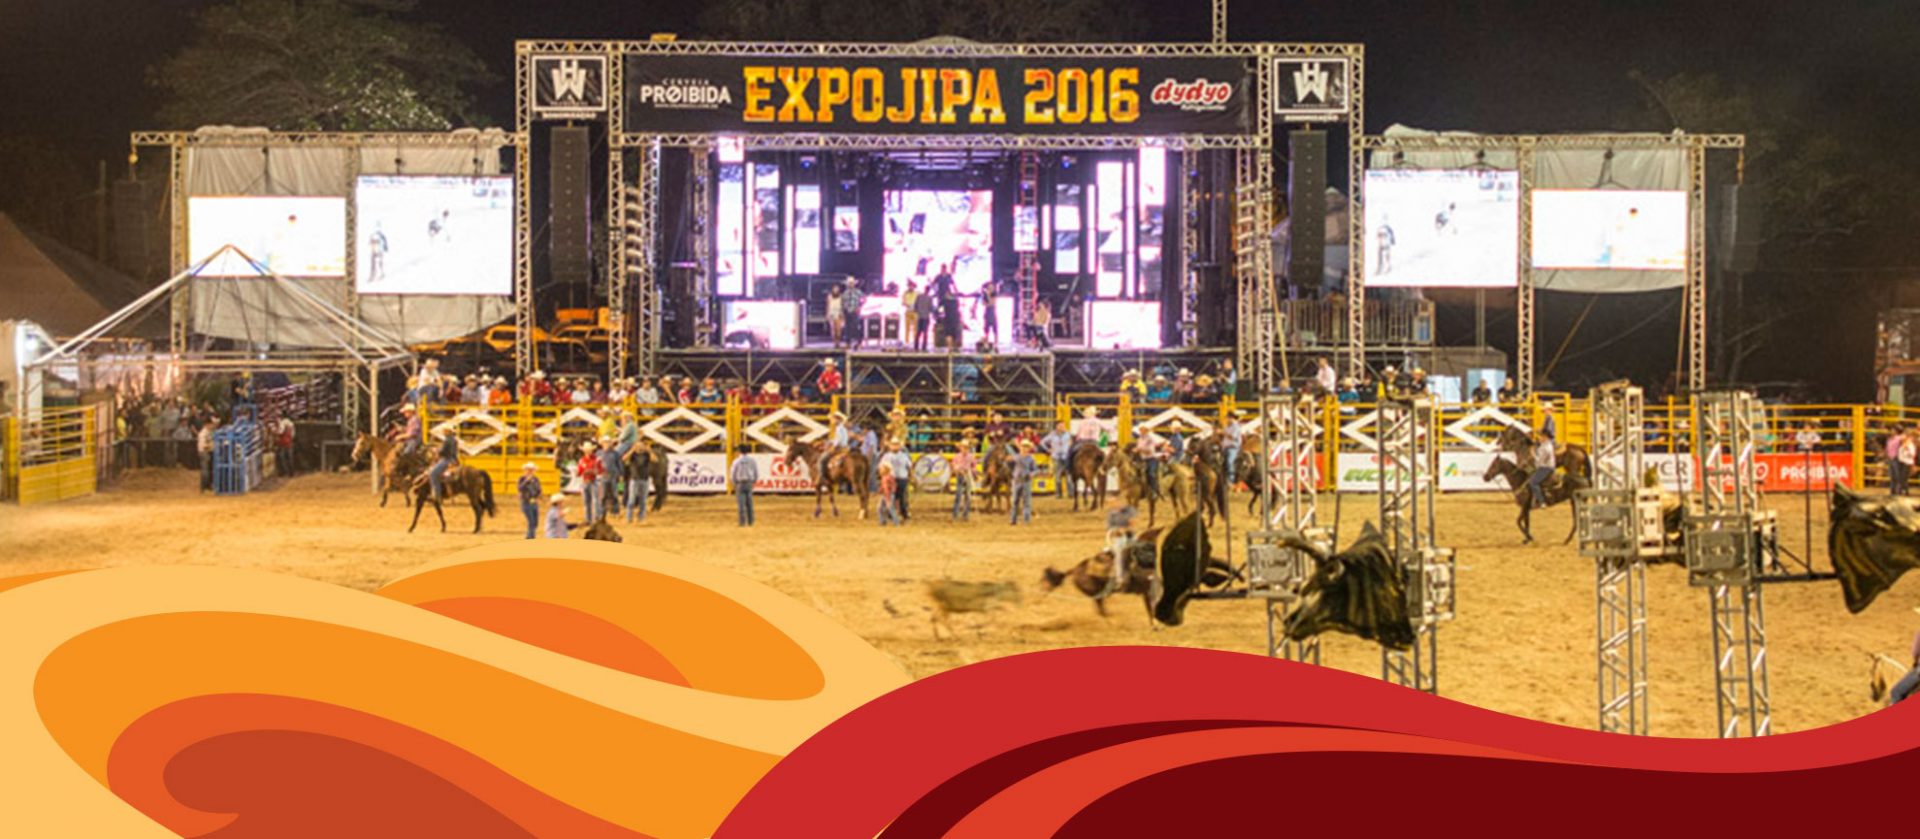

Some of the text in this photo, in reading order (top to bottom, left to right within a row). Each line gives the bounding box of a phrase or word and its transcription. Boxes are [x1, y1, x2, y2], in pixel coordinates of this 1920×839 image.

[743, 67, 1140, 123] EXPOJIPA 2016
[1151, 79, 1232, 104] dydyo
